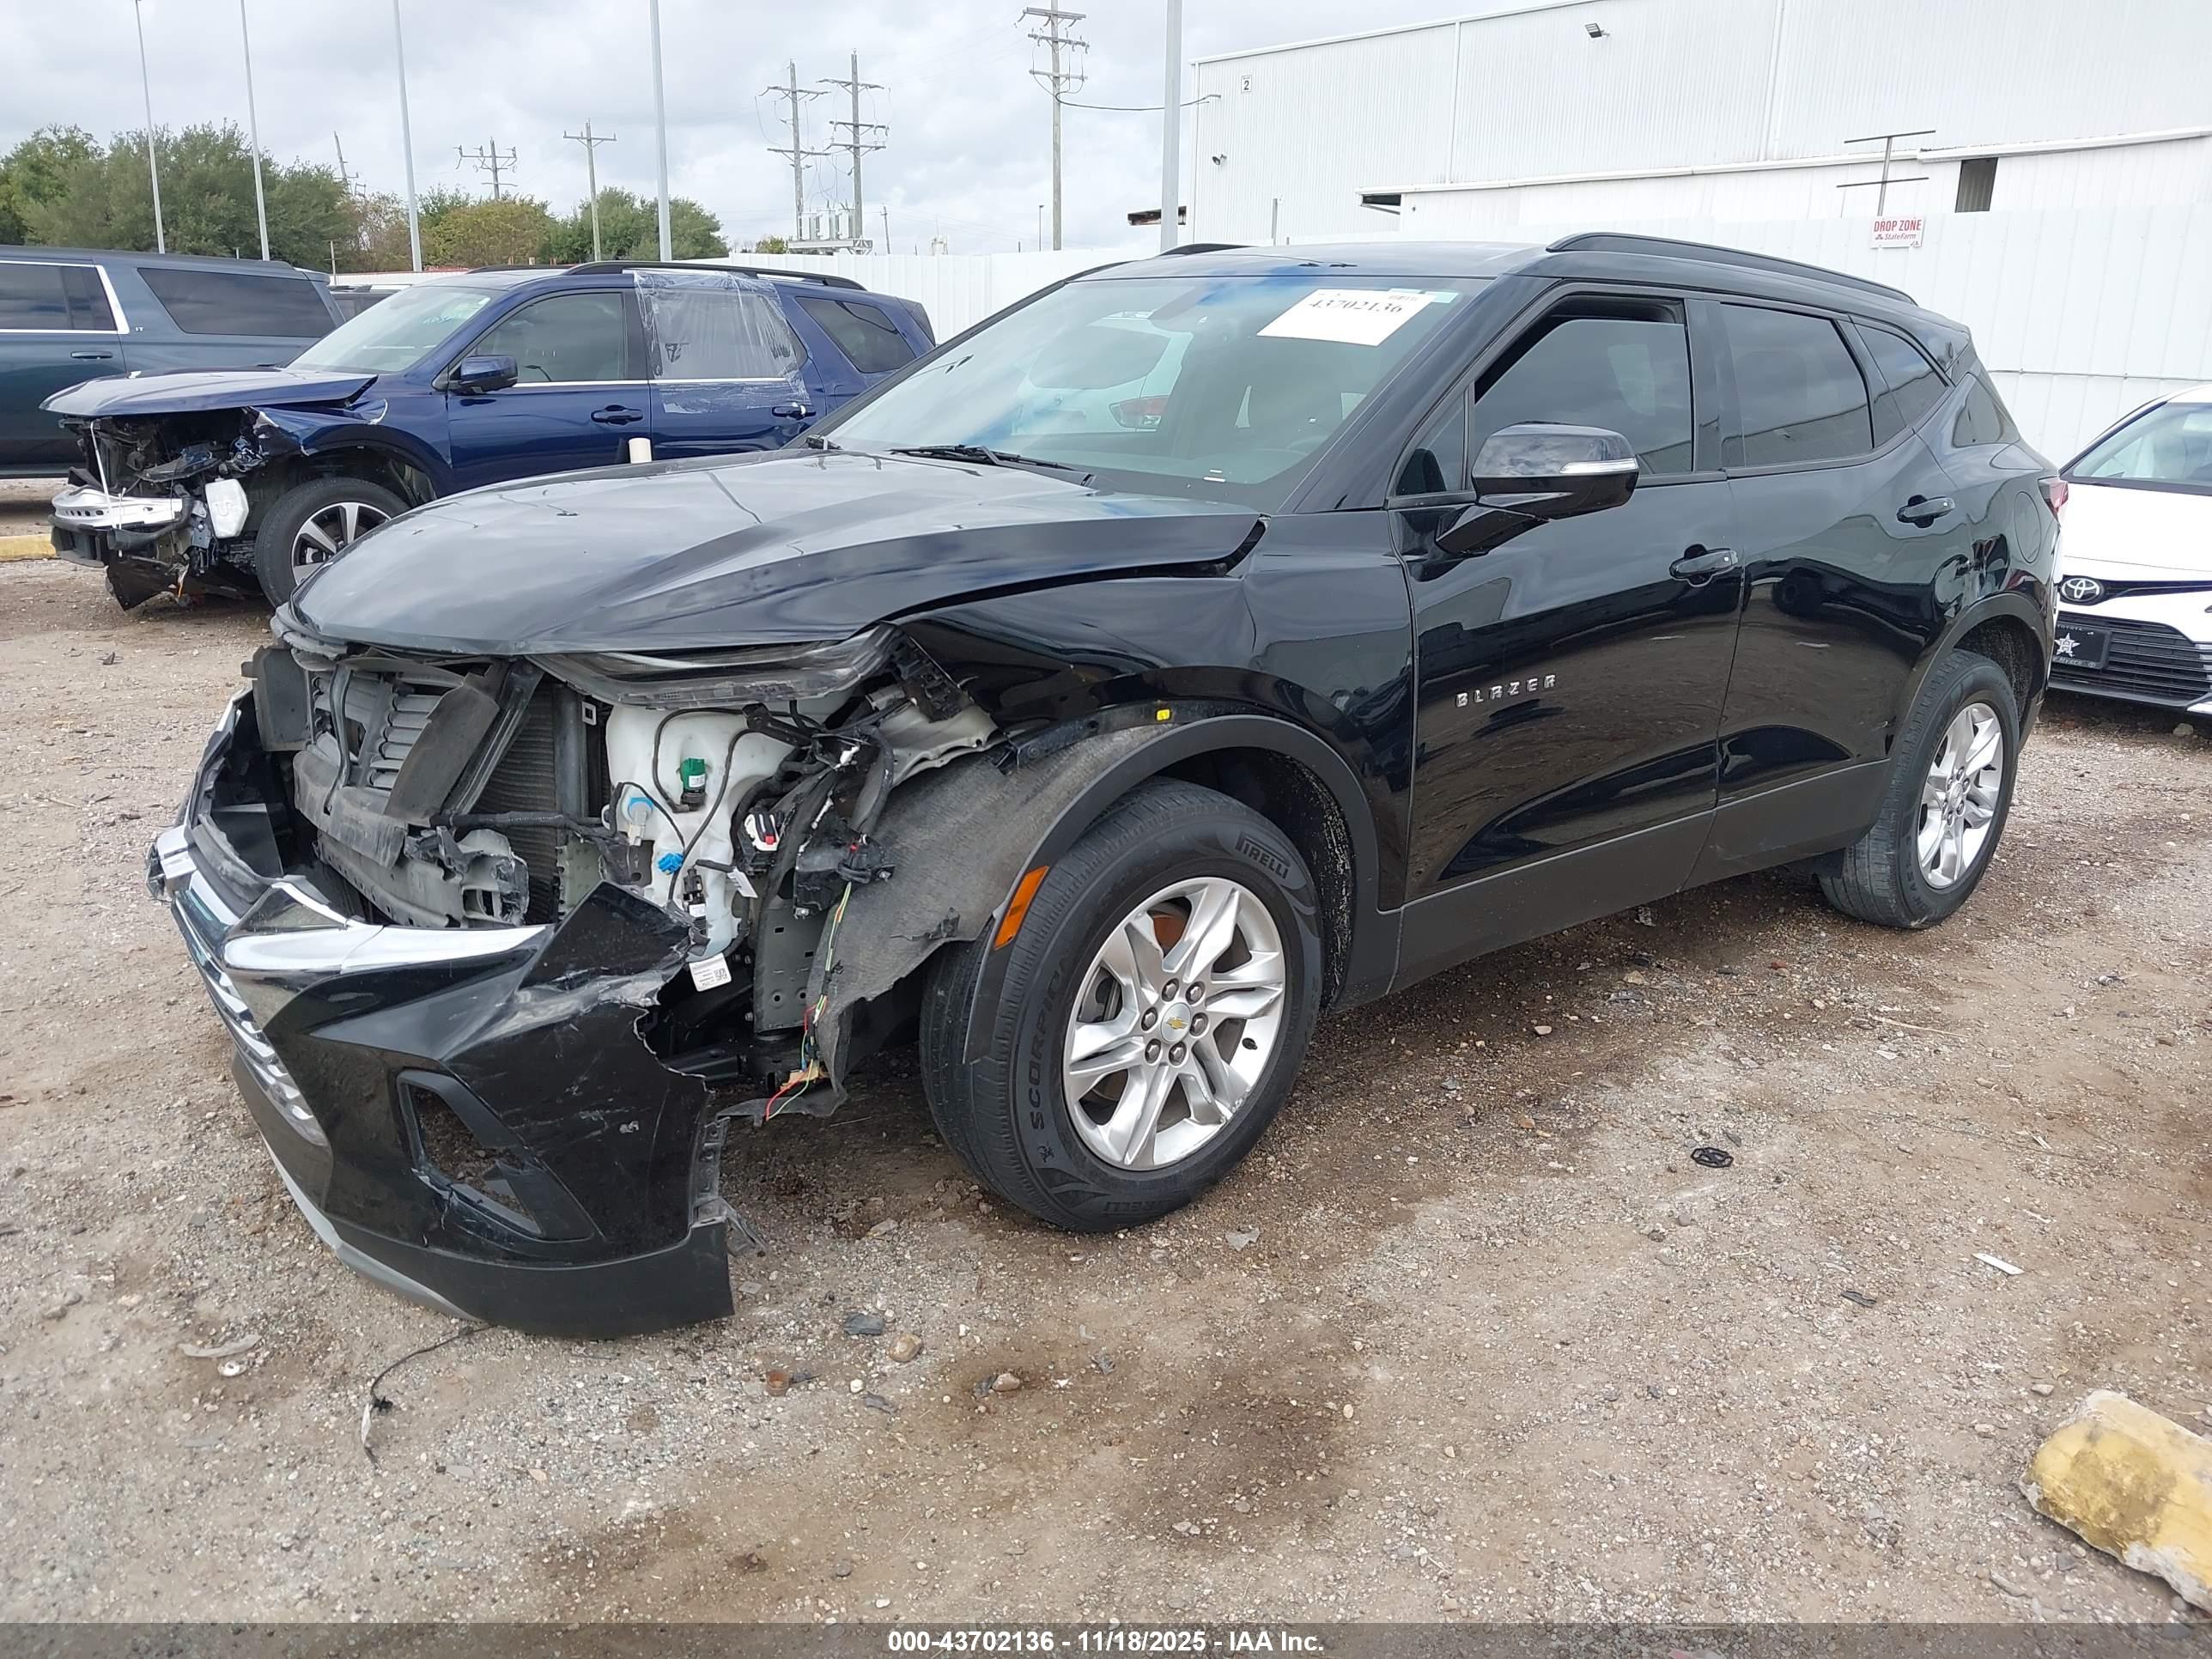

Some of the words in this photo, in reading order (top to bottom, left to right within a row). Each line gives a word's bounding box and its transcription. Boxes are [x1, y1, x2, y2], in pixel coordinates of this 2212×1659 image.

[1243, 80, 1249, 91] 2
[1874, 221, 1898, 232] DROP
[1899, 220, 1922, 231] ZONE
[1308, 299, 1403, 314] 43702136
[1456, 674, 1556, 708] BLAZER
[1236, 834, 1291, 879] PIRELLI
